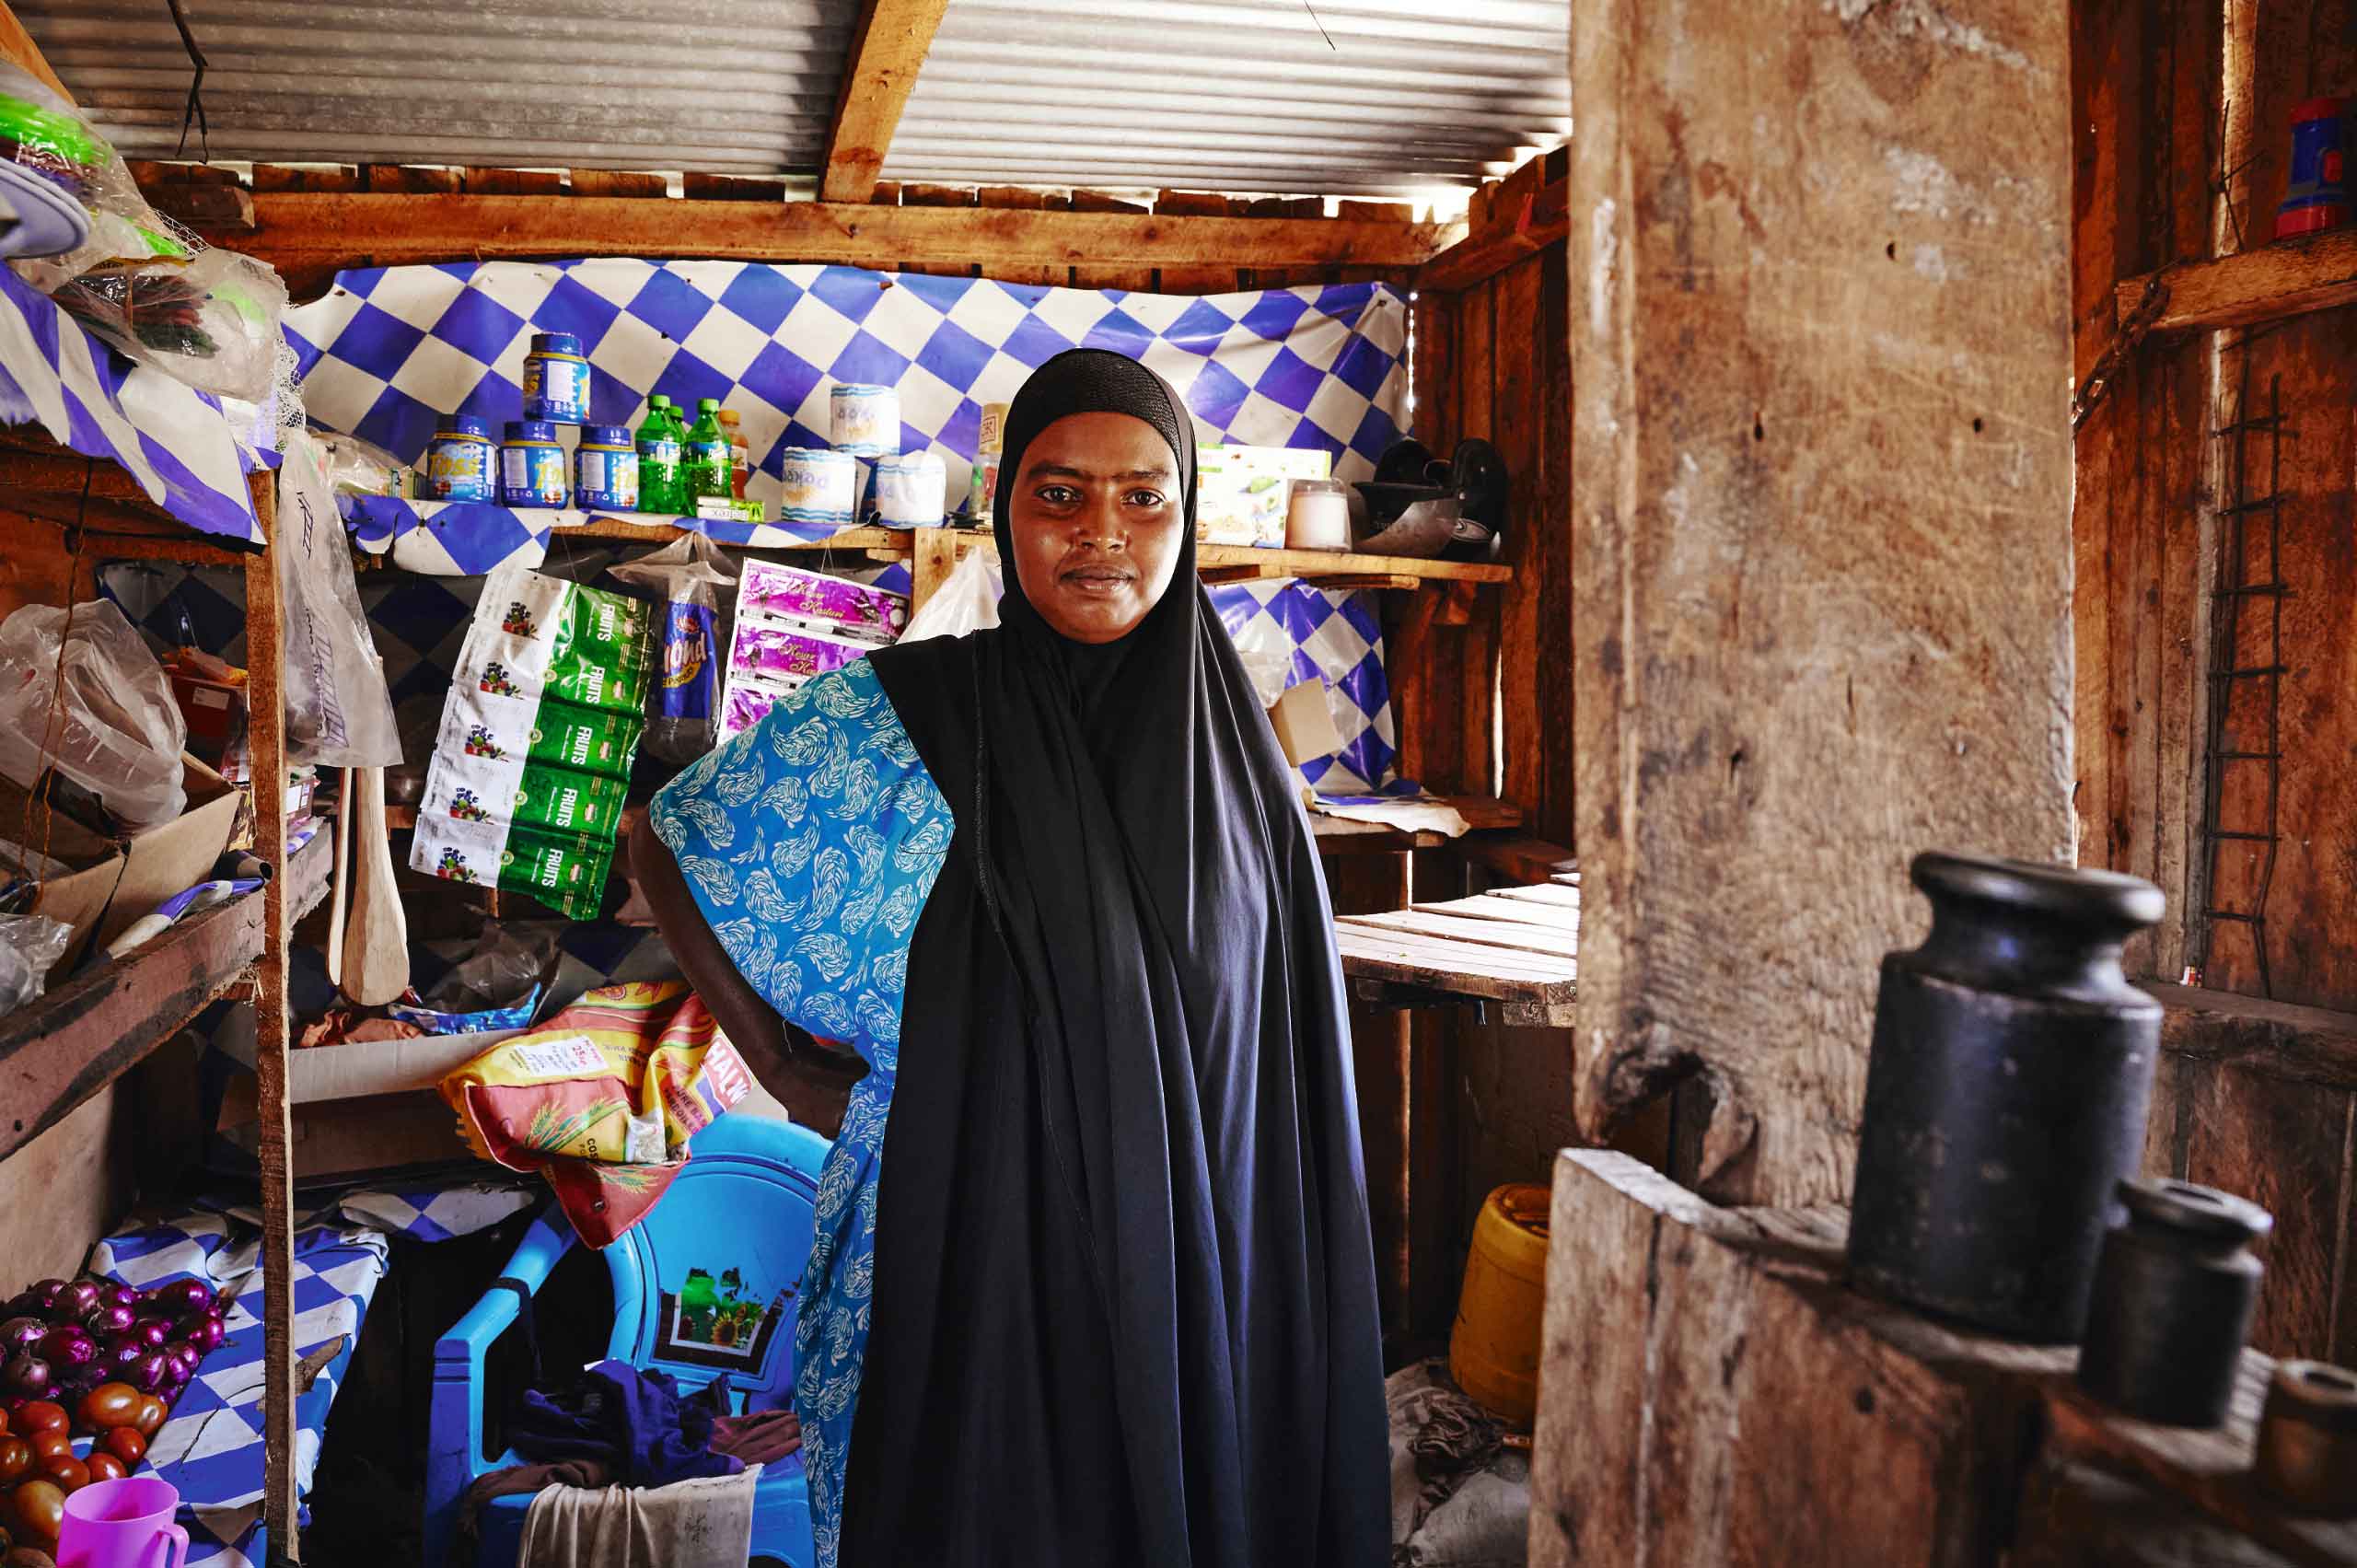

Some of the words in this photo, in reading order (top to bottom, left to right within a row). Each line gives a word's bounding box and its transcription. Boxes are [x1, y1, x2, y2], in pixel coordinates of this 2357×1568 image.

[597, 603, 616, 642] FRUITS
[585, 665, 606, 704] FRUITS
[570, 726, 594, 766] FRUITS
[555, 787, 578, 828] FRUITS
[540, 848, 564, 889] FRUITS
